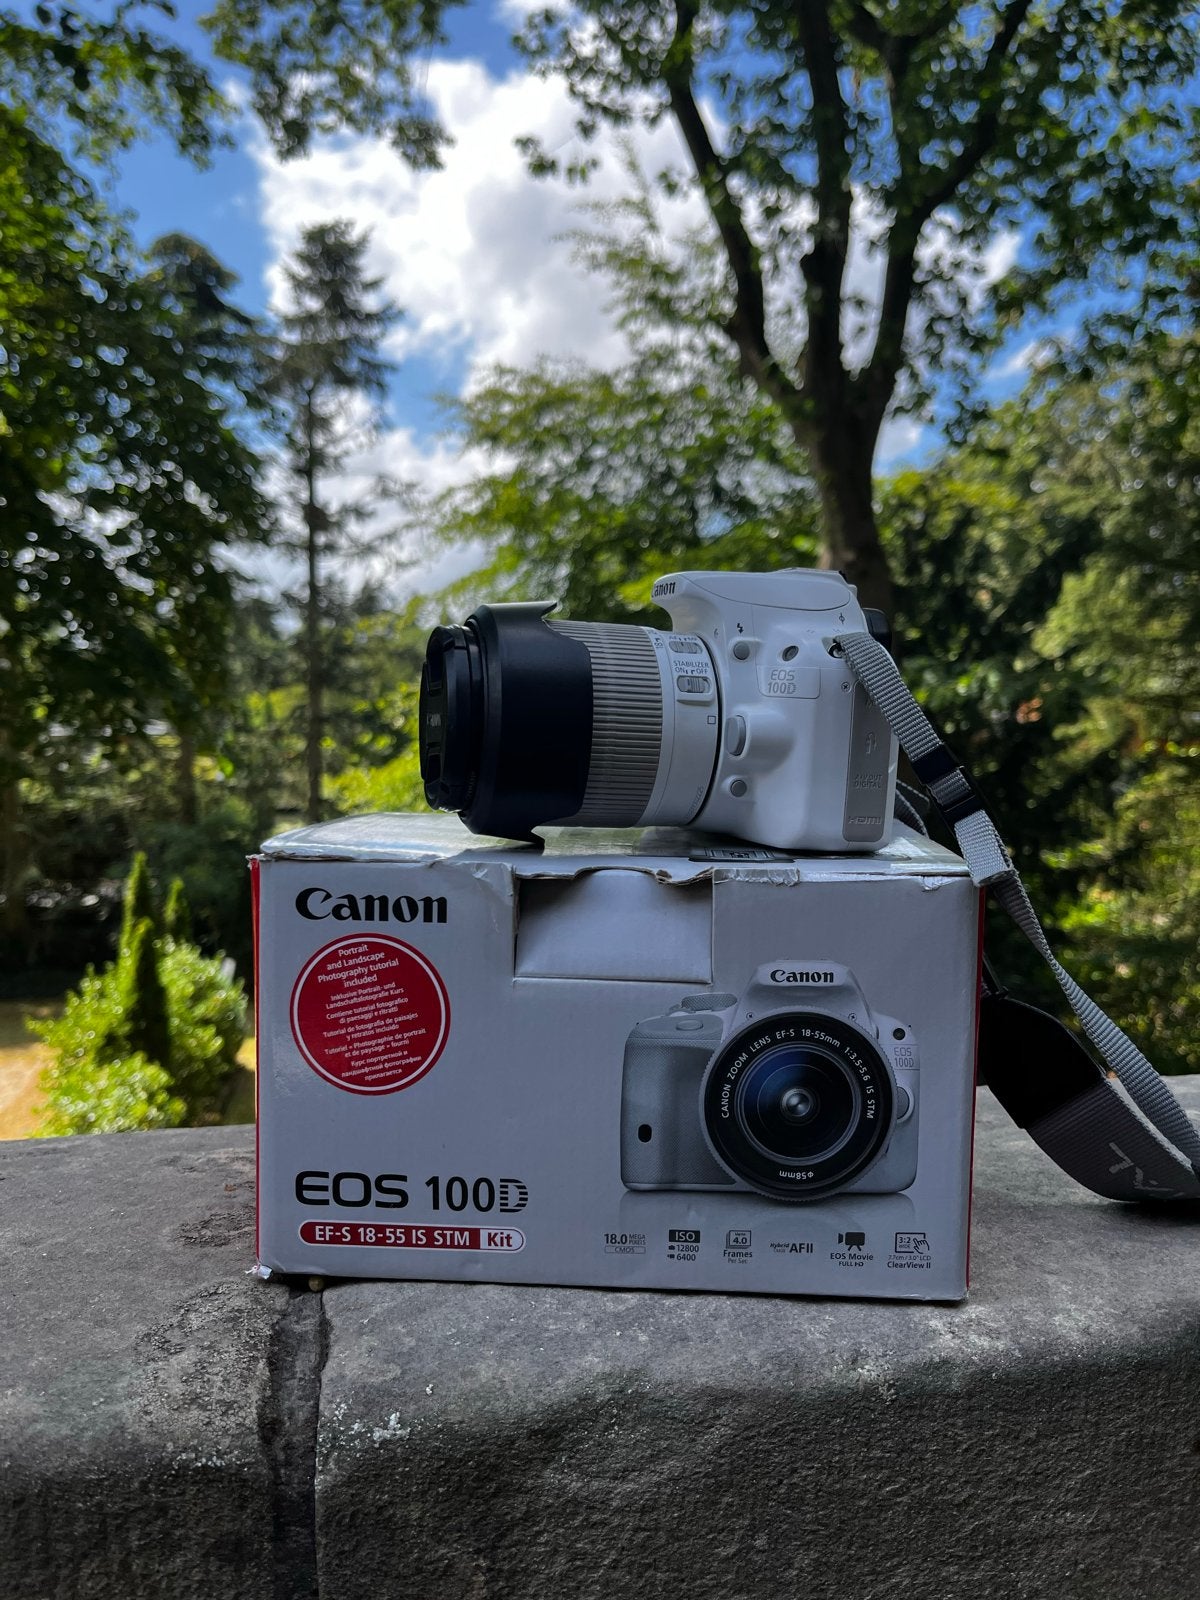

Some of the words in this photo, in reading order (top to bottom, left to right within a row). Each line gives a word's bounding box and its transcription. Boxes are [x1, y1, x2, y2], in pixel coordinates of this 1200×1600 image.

[673, 660, 709, 668] STABILIZER
[770, 669, 795, 680] EOS
[767, 682, 796, 694] 100D
[295, 888, 448, 923] Canon
[338, 944, 368, 956] Portrait
[327, 961, 342, 970] and
[344, 952, 384, 967] Landscape
[318, 966, 368, 983] Photography
[369, 958, 399, 971] tutorial
[770, 969, 834, 983] Canon
[344, 974, 377, 987] included
[331, 991, 357, 1001] Inklusive
[326, 1009, 353, 1019] Contiene
[354, 1004, 375, 1013] tutorial
[376, 997, 408, 1009] fotografico
[347, 1012, 373, 1022] paesaggi
[379, 1006, 398, 1015] ritratti
[323, 1028, 346, 1038] Tutorial
[394, 1012, 418, 1023] paisajes
[351, 1029, 374, 1038] retratos
[354, 1035, 394, 1048] Photographie
[403, 1028, 426, 1038] portrait
[776, 1029, 795, 1039] EF-S
[801, 1028, 840, 1048] 18-55mm
[360, 1046, 385, 1055] paysage
[750, 1036, 771, 1053] LENS
[894, 1047, 912, 1056] EOS
[727, 1053, 749, 1080] ZOOM
[844, 1047, 870, 1081] 1:3.5-5.6
[895, 1058, 914, 1068] 100D
[866, 1086, 874, 1094] IS
[721, 1084, 731, 1118] CANON
[867, 1099, 875, 1119] STM
[295, 1171, 409, 1209] EOS
[425, 1176, 528, 1213] 100D
[315, 1225, 351, 1242] EF-S
[358, 1227, 405, 1244] 18-55
[412, 1229, 426, 1244] IS
[434, 1230, 470, 1246] STM
[487, 1232, 512, 1247] Kit
[604, 1234, 628, 1244] 18.0
[675, 1232, 695, 1241] ISO
